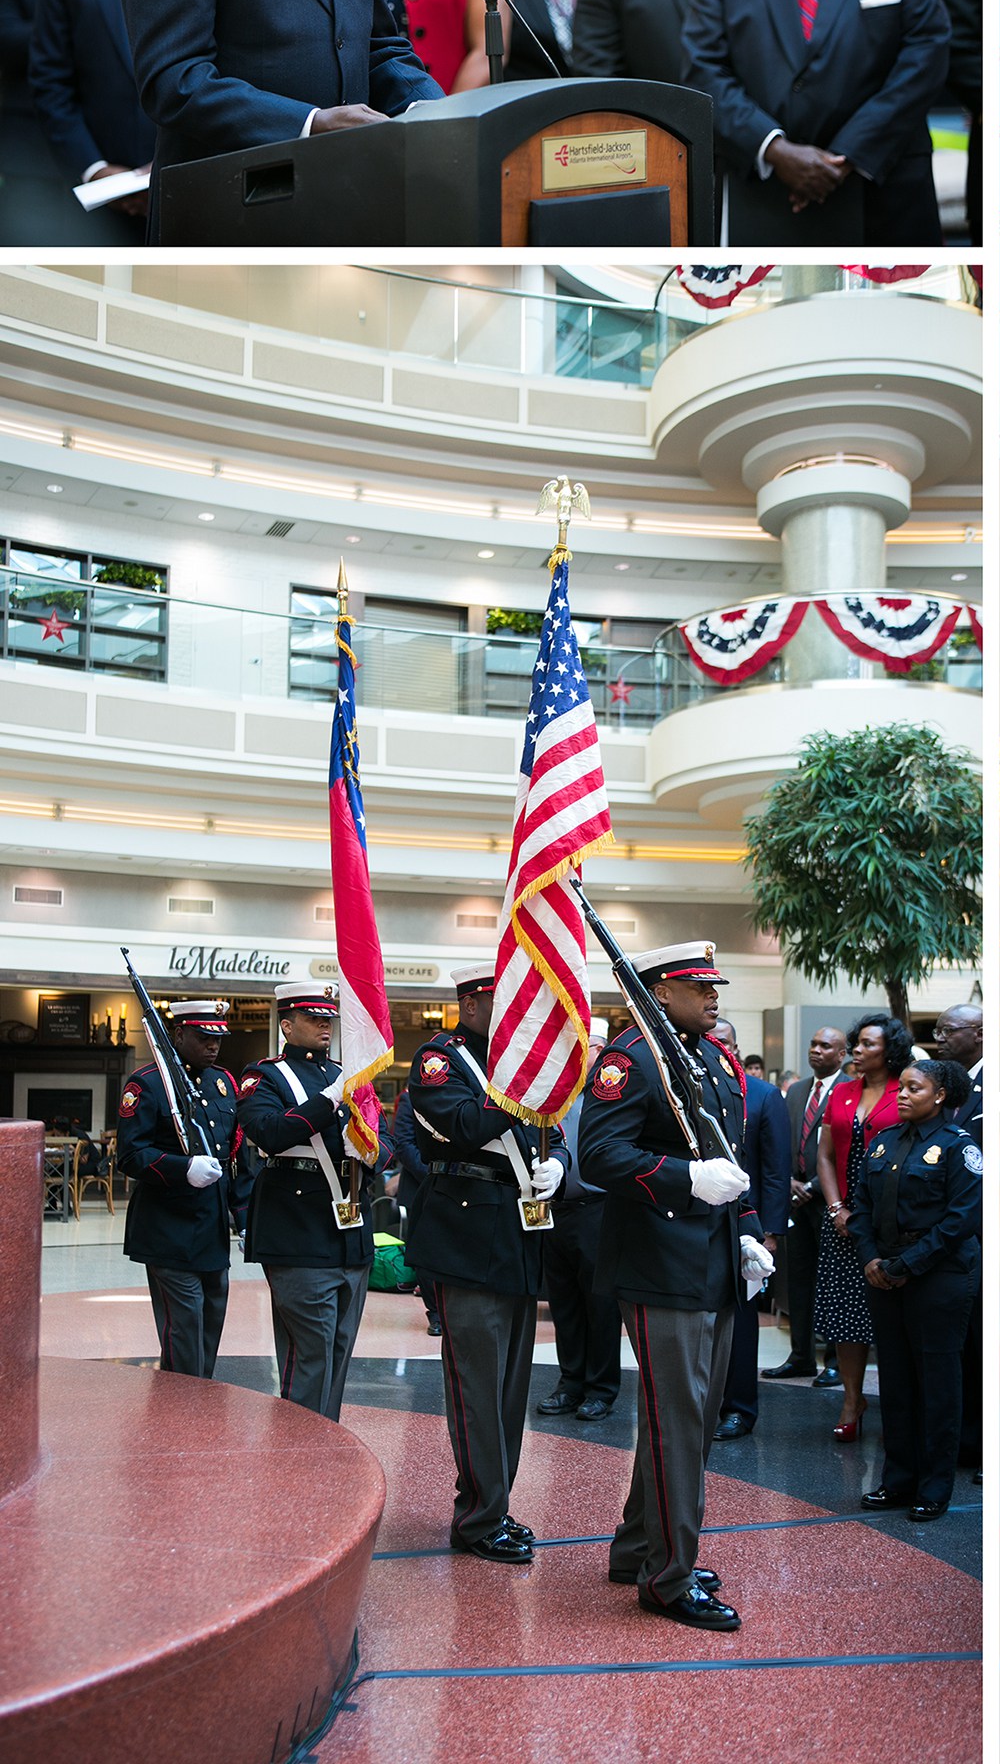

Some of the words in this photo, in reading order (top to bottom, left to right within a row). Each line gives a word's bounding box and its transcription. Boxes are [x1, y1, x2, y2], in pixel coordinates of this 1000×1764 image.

[568, 141, 632, 156] Hartsfield-Jackson
[569, 156, 586, 164] Atlanta
[586, 153, 615, 163] International
[168, 946, 187, 971] la
[179, 946, 291, 980] Madeleine
[408, 967, 433, 977] CAFE
